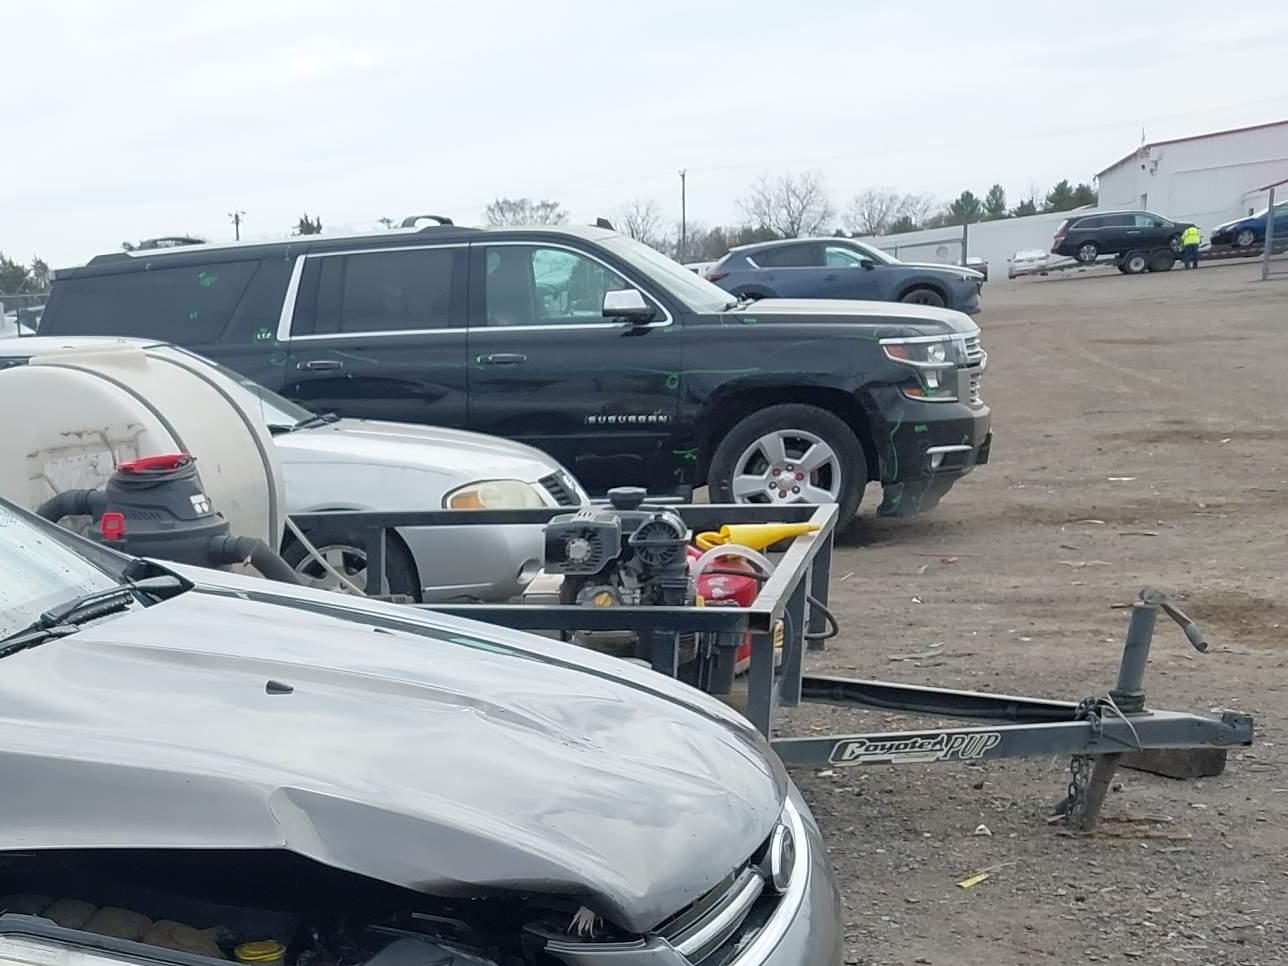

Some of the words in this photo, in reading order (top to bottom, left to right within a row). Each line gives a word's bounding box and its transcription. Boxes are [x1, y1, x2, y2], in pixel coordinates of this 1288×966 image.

[588, 415, 668, 424] SUBURBAN
[829, 738, 933, 766] Coyote
[940, 733, 1001, 760] PUP
